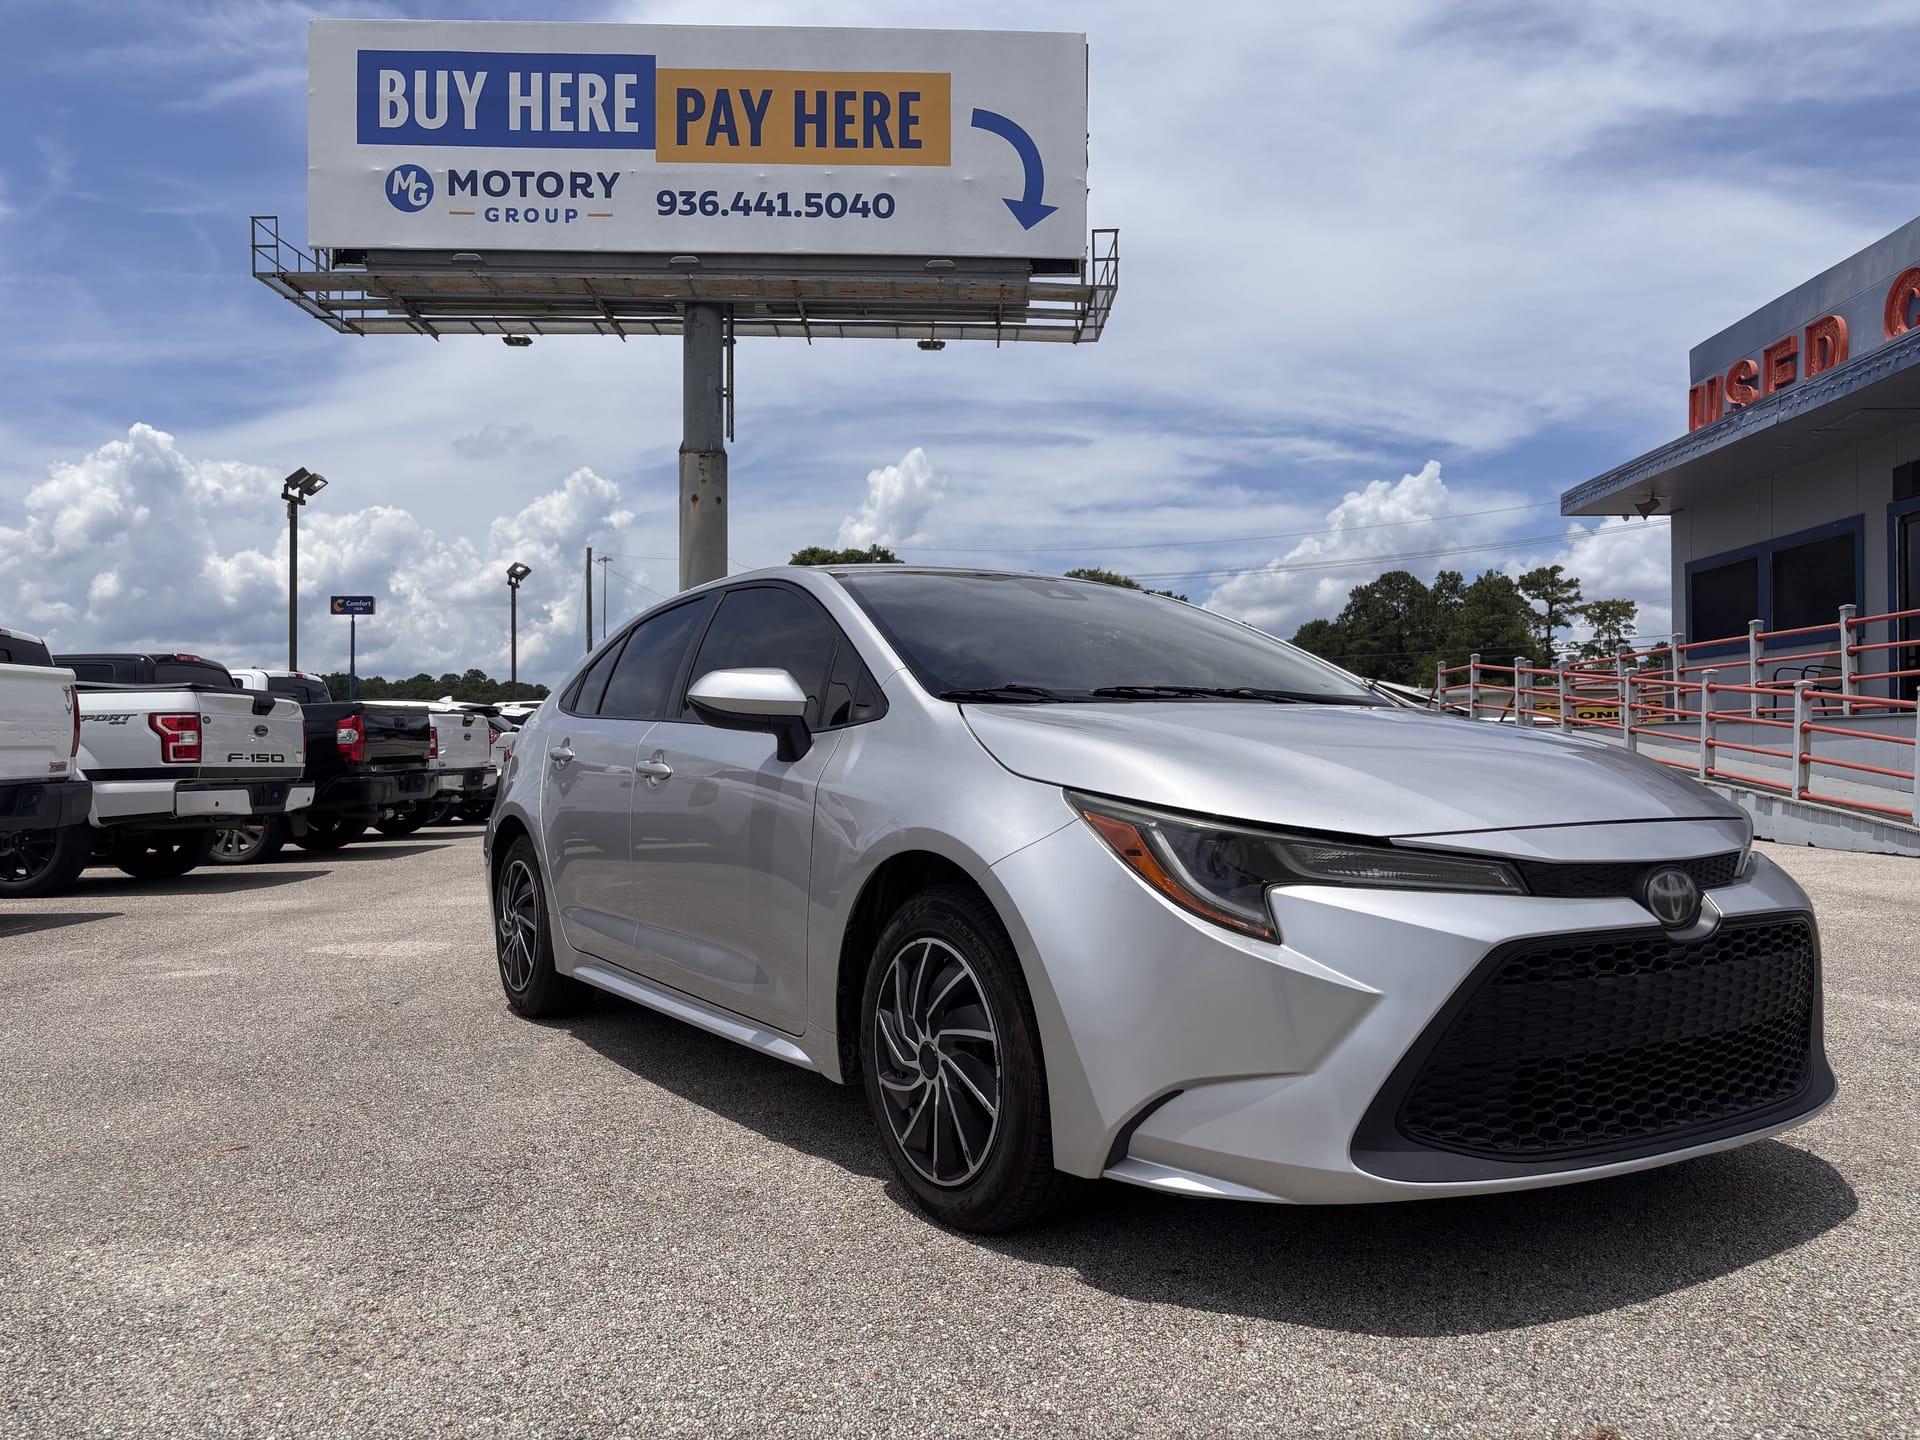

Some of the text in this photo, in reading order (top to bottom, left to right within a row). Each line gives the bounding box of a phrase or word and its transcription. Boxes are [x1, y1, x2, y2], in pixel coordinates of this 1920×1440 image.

[378, 69, 923, 150] BUY HERE PAY HERE
[392, 170, 428, 206] MG
[448, 169, 620, 199] MOTORY
[484, 207, 579, 224] GROUP
[656, 189, 896, 219] 936.441.5040
[1688, 315, 1849, 433] USED
[80, 713, 138, 722] PORT
[227, 753, 285, 763] F-150
